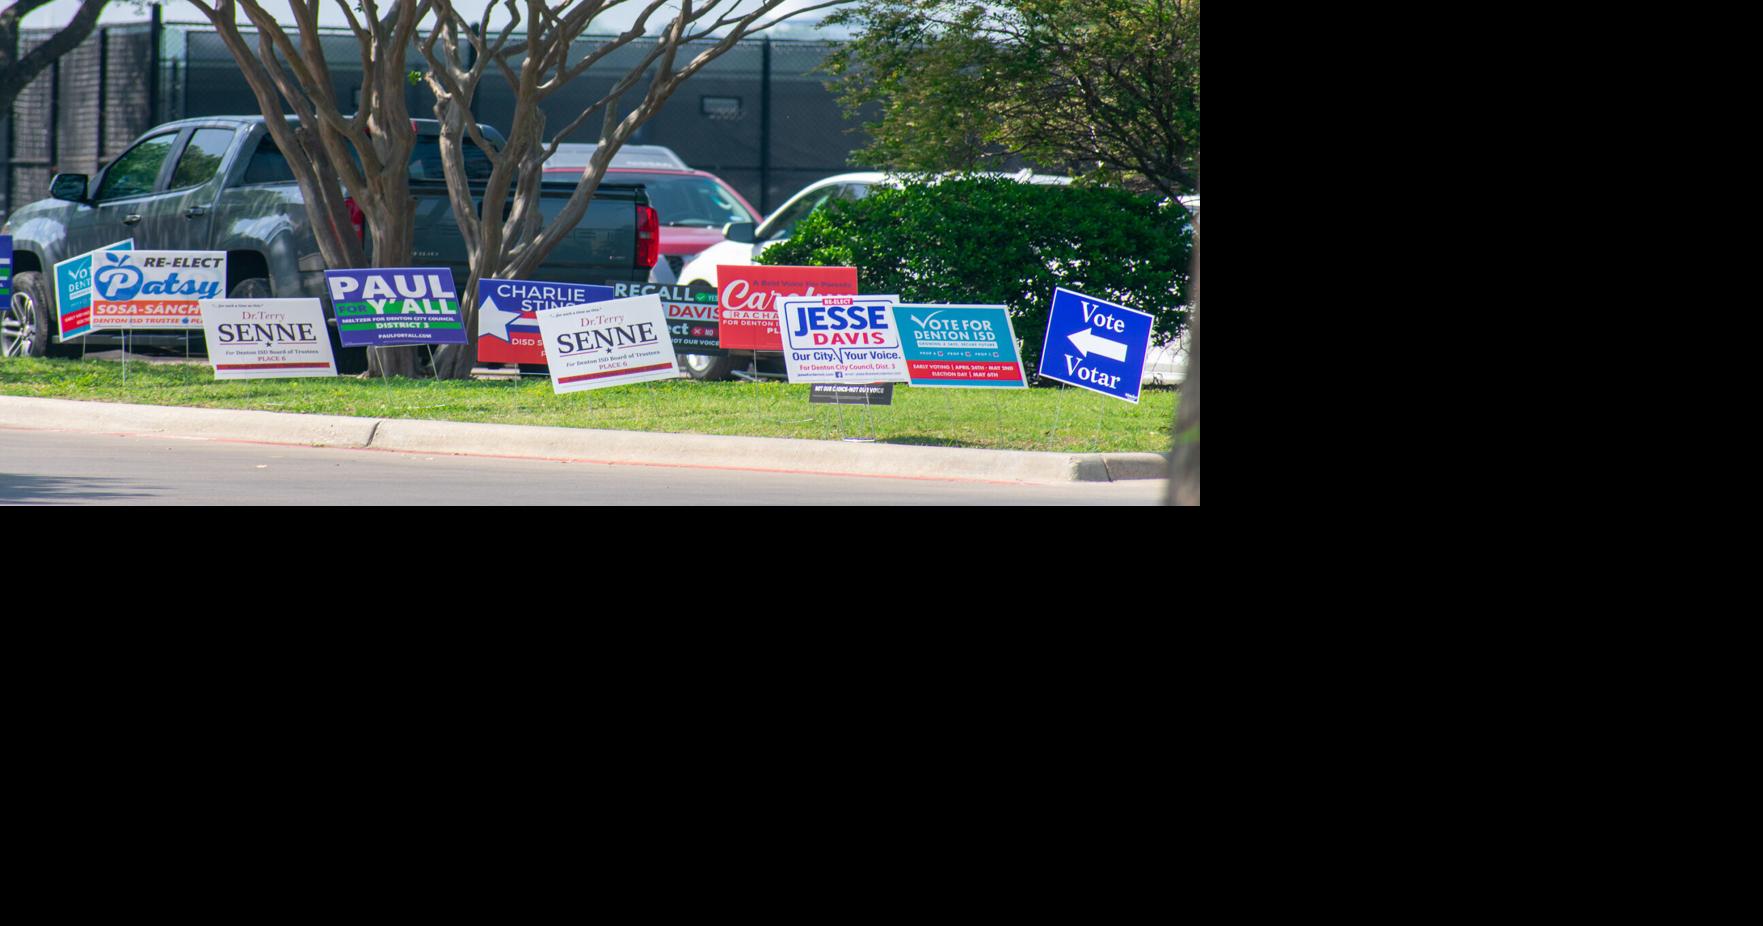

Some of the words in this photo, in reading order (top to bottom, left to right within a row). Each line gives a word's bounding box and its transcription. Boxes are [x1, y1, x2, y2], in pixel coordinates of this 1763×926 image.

[144, 257, 224, 269] RE-ELECT
[68, 262, 91, 280] VO
[69, 278, 91, 293] DENT
[98, 265, 223, 300] Patsy
[328, 274, 455, 300] PAUL
[497, 284, 586, 302] CHARLIE
[614, 283, 694, 301] RECALL
[96, 302, 200, 315] SOSA-SÁNCH
[338, 304, 366, 313] FOR
[367, 299, 456, 315] Y'ALL
[242, 311, 257, 320] Dr.
[257, 310, 286, 321] Terry
[581, 316, 596, 327] Dr.
[596, 314, 625, 325] Terry
[733, 311, 779, 319] RACHA
[794, 306, 888, 336] JESSE
[911, 310, 959, 331] VOTE
[962, 319, 993, 331] FOR
[1081, 300, 1125, 333] Vote
[218, 322, 317, 342] SENNE
[376, 321, 421, 329] DISTRICT
[705, 328, 714, 337] NO
[512, 338, 535, 346] DISD
[556, 321, 658, 354] SENNE
[813, 332, 885, 346] DAVIS
[914, 330, 970, 341] DENTON
[973, 330, 996, 341] ISD
[792, 352, 810, 361] Our
[813, 351, 836, 362] City.
[844, 351, 867, 360] Your
[869, 351, 902, 360] Voice.
[599, 362, 621, 370] PLACE
[1064, 353, 1121, 389] Votar
